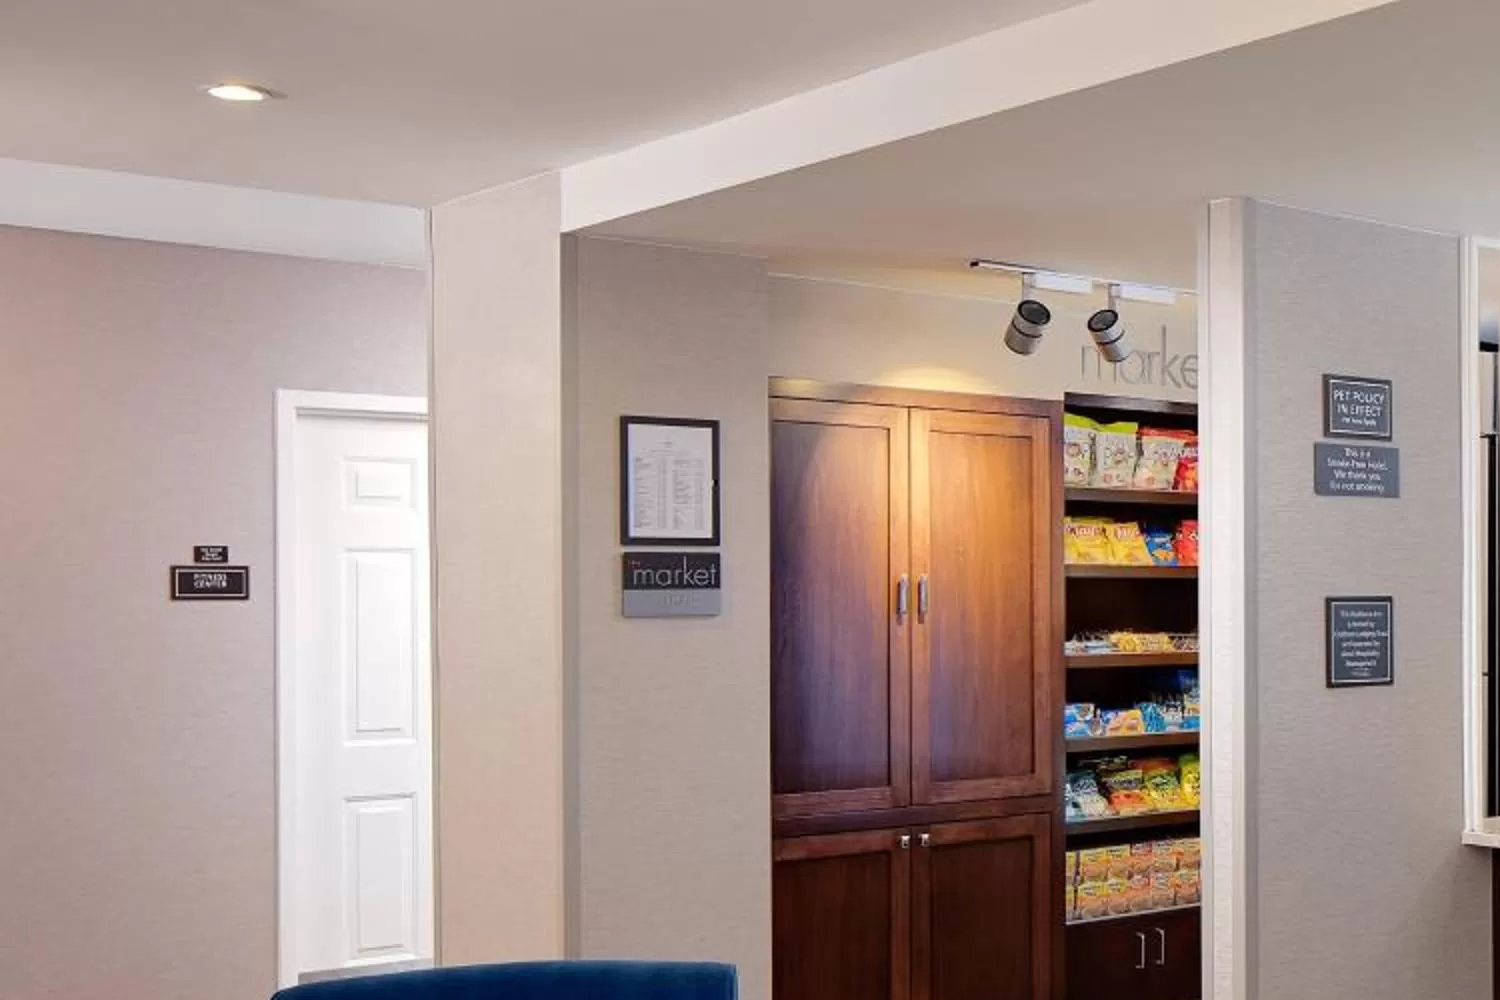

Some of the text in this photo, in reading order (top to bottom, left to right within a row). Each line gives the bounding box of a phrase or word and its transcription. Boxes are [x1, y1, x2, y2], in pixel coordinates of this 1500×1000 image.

[1333, 389, 1384, 404] PET POLICY
[1336, 403, 1382, 417] IN EFFECT
[633, 555, 718, 587] market
